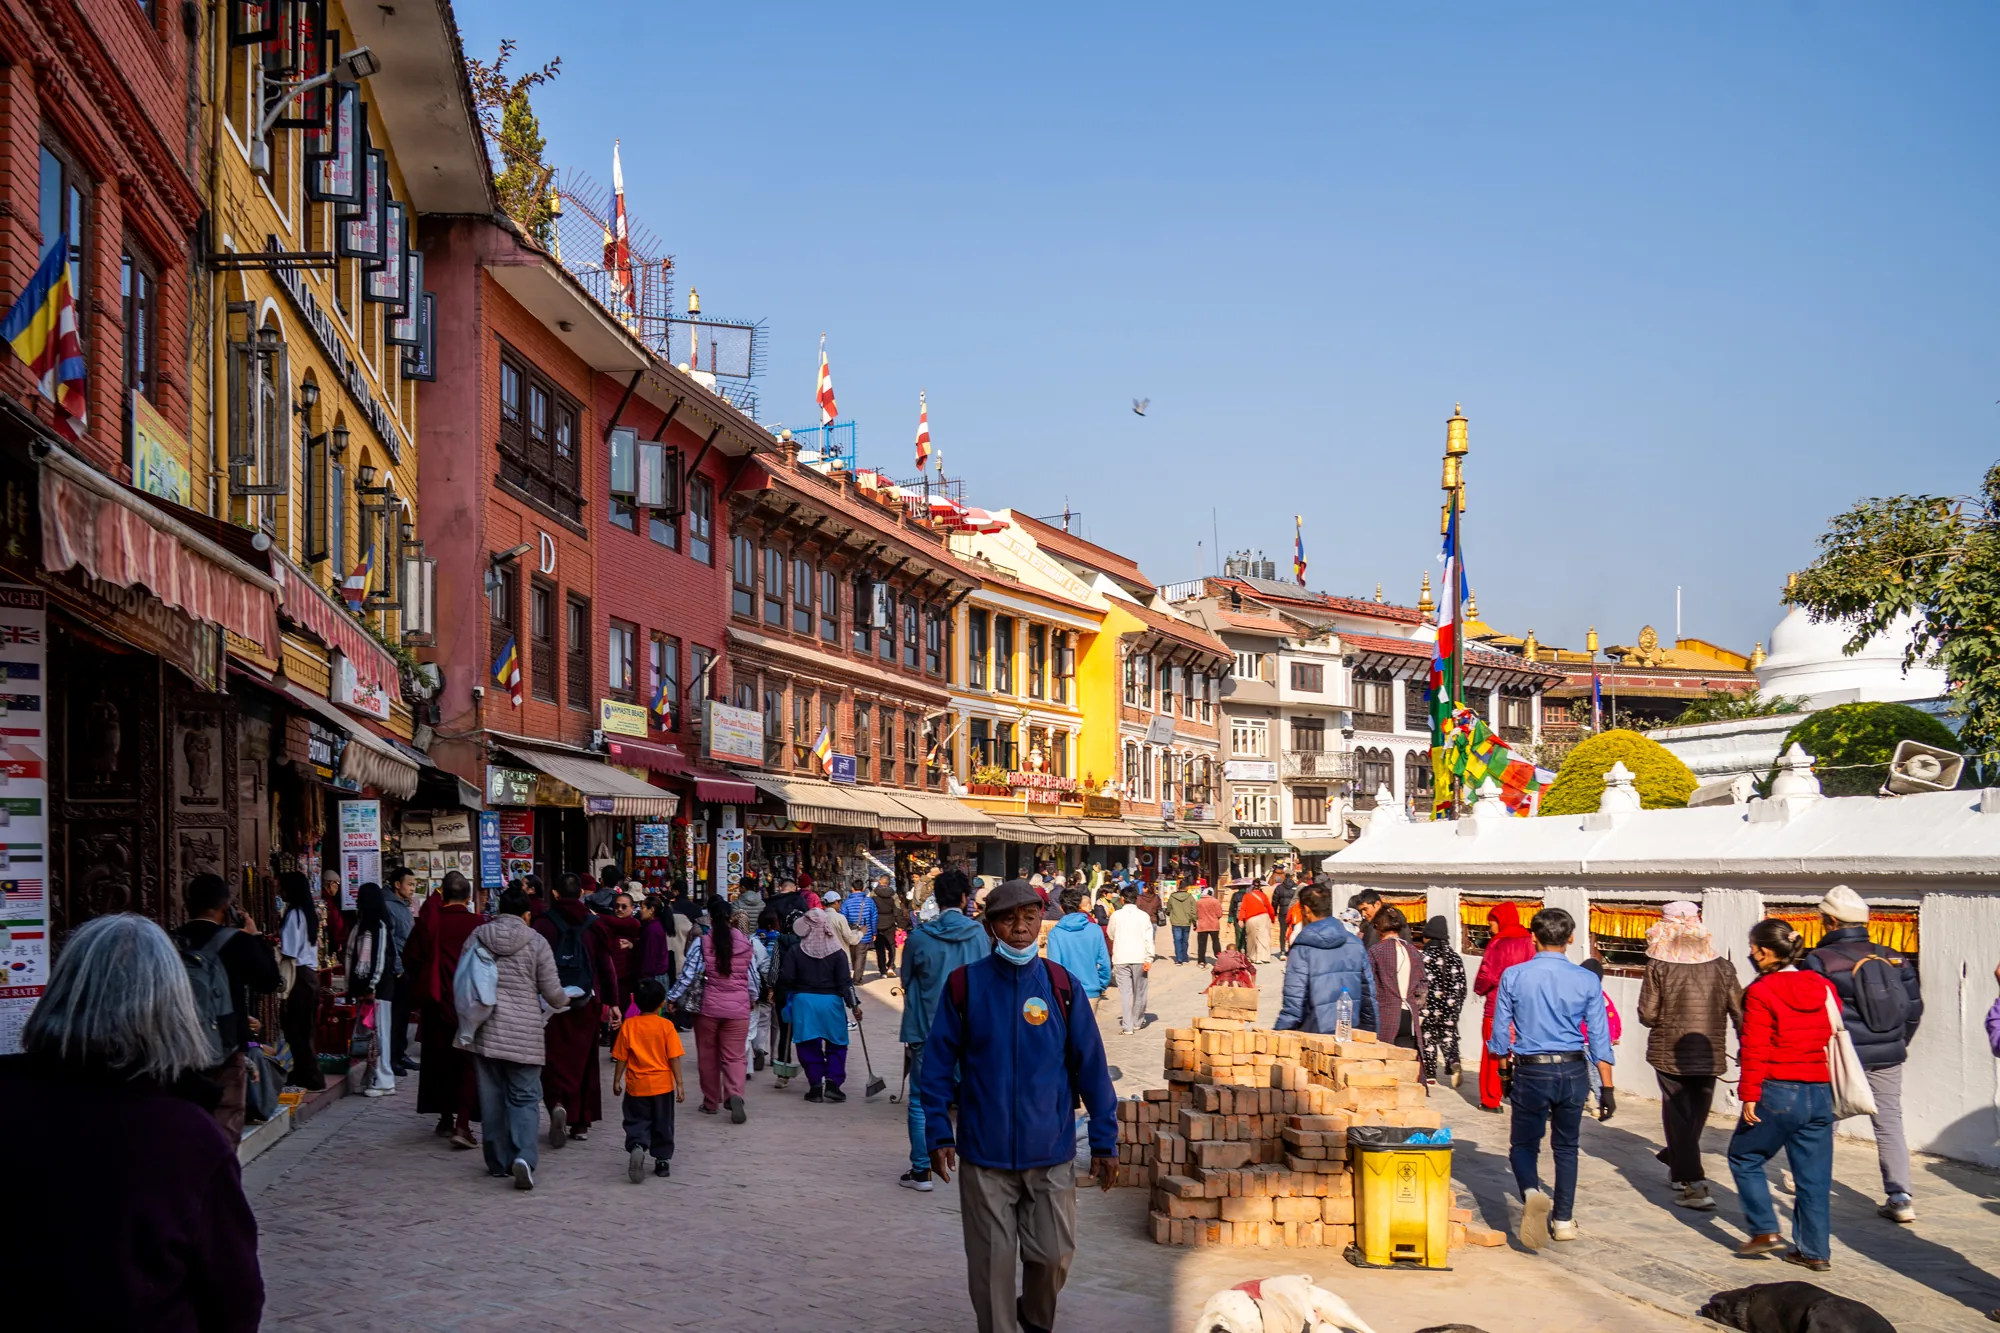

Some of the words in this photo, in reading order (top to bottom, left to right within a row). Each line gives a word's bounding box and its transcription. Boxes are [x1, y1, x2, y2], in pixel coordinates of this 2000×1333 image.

[324, 168, 351, 181] Light
[351, 226, 376, 239] Light
[375, 274, 397, 287] Light
[538, 531, 556, 574] D
[611, 705, 631, 716] NAMASTE
[1239, 828, 1274, 837] PAHUNA
[343, 840, 378, 848] CHANGER
[11, 987, 39, 997] RATE
